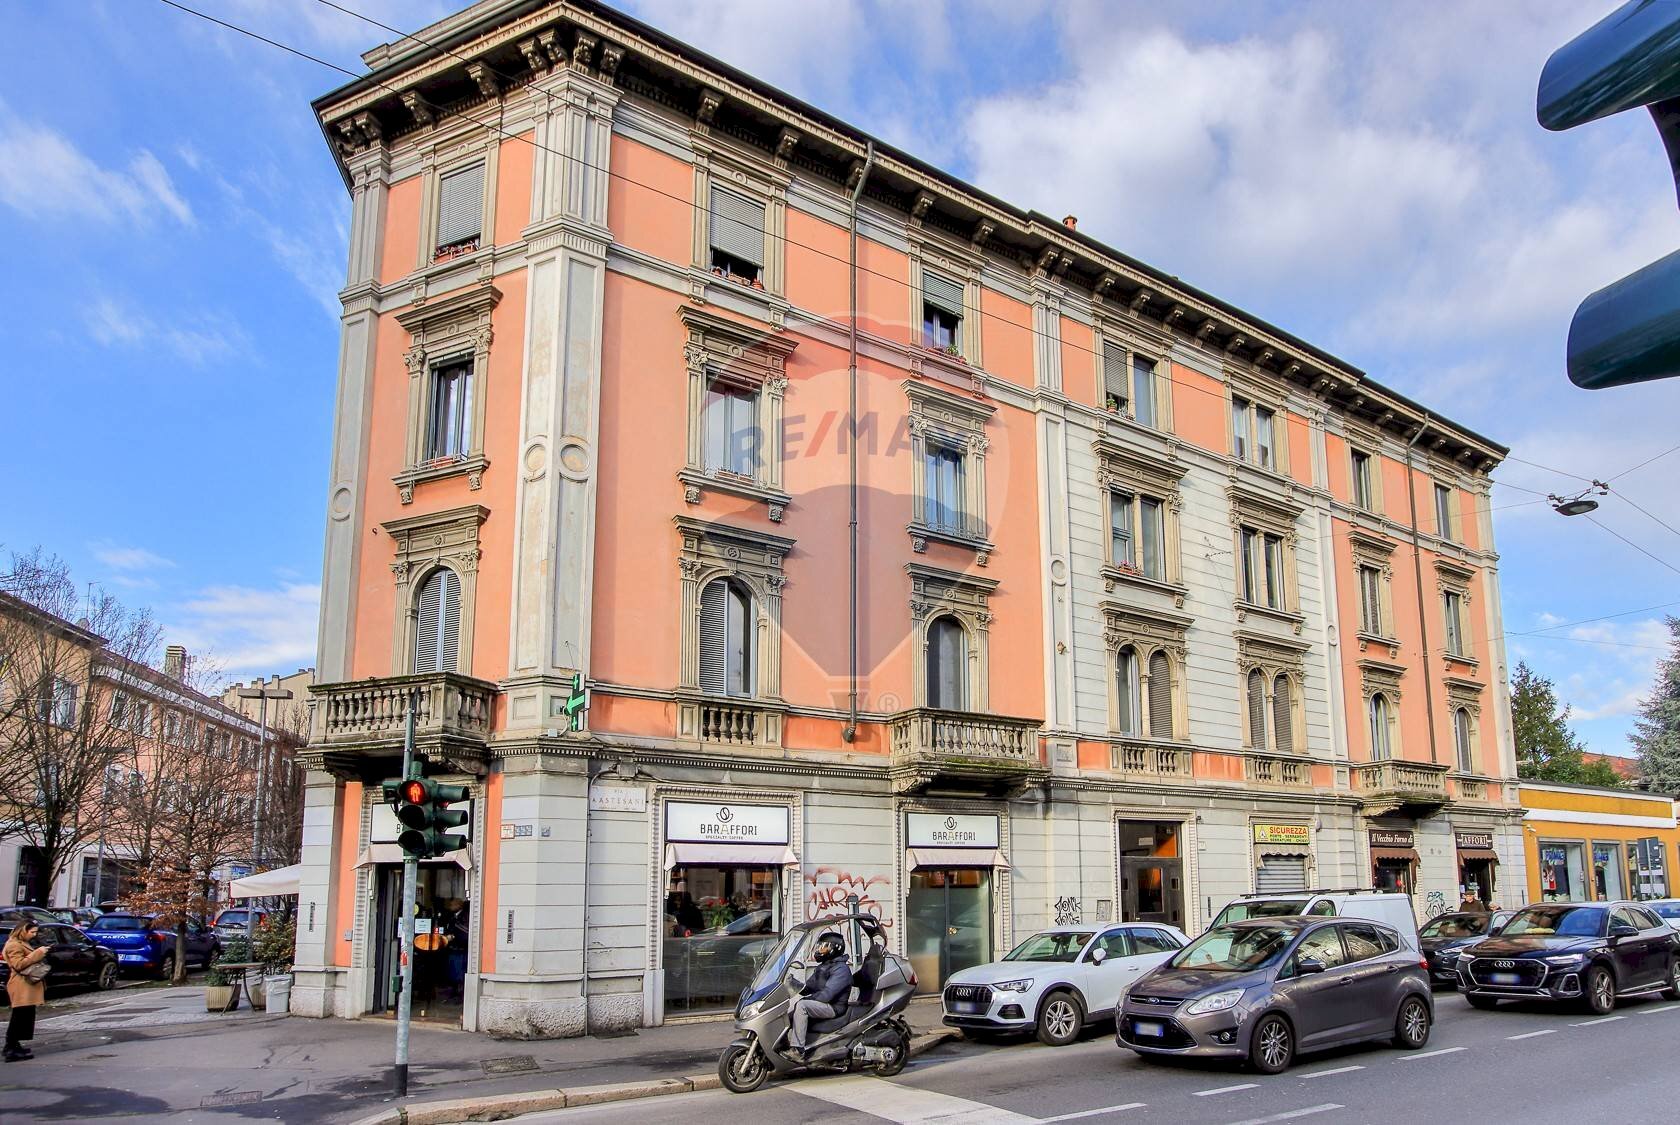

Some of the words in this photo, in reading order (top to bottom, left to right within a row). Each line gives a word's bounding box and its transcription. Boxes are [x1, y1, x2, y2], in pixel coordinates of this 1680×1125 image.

[700, 823, 758, 835] BARAFFORI
[1269, 826, 1307, 835] SICUREZZA
[932, 831, 976, 841] BARAFFORI
[1376, 833, 1394, 843] Vecchio
[1393, 834, 1408, 843] Forno
[1408, 834, 1413, 843] di
[1463, 836, 1487, 845] AFFORI
